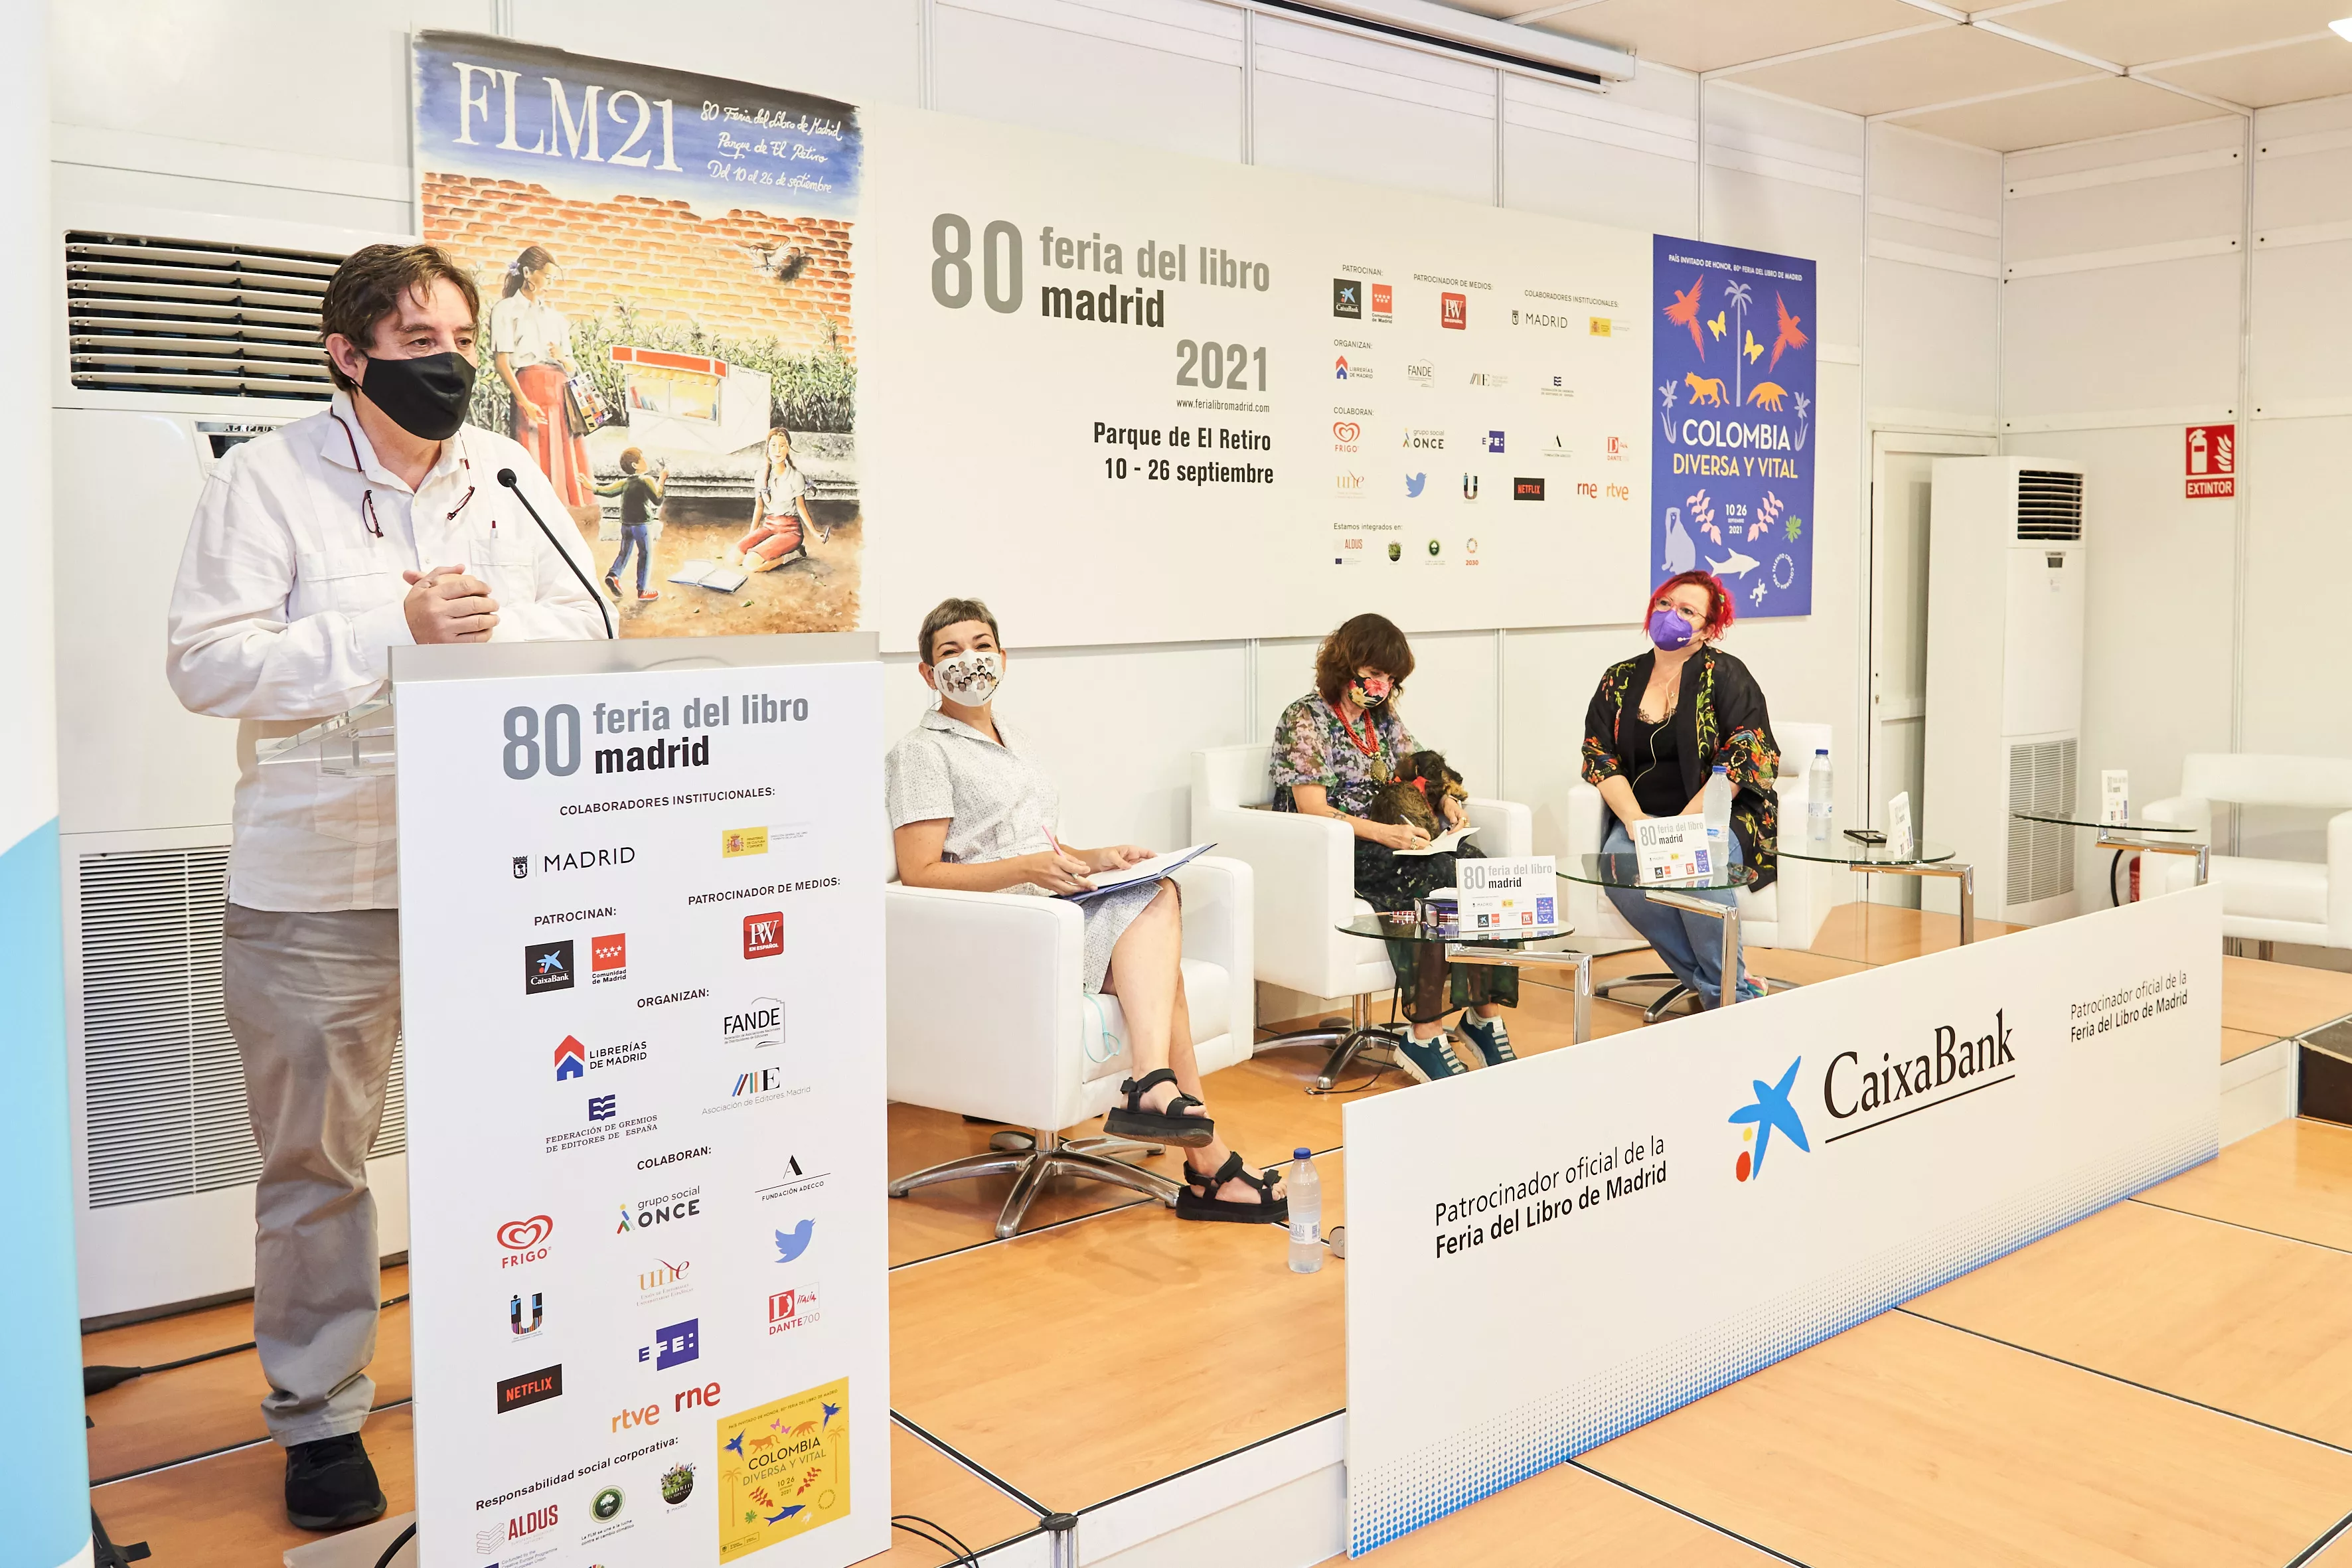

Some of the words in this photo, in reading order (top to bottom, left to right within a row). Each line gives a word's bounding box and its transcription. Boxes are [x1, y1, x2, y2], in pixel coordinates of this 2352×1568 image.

[452, 62, 683, 172] FLM21
[700, 100, 719, 121] 80
[724, 107, 752, 124] Feria
[753, 109, 769, 128] del
[769, 111, 795, 129] Libro
[797, 115, 808, 133] de
[807, 118, 842, 141] Madrid
[718, 131, 751, 159] Parque
[754, 139, 767, 154] de
[769, 141, 786, 158] El
[791, 143, 828, 163] Retiro
[708, 160, 731, 181] Del
[733, 167, 746, 181] 10
[747, 170, 758, 184] al
[759, 171, 773, 185] 26
[775, 172, 786, 187] de
[787, 173, 832, 195] septiembre
[931, 213, 1023, 314] 80
[1040, 226, 1123, 275] feria
[1137, 239, 1186, 282] del
[1200, 246, 1270, 292] libro
[1342, 264, 1383, 276] PATROCINAN:
[1669, 254, 1680, 263] PAÍS
[1680, 256, 1704, 266] INVITADO
[1413, 274, 1458, 286] PATROCINADOR
[1469, 281, 1493, 290] MEDIOS:
[1042, 284, 1164, 328] madrid
[1525, 289, 1571, 302] COLABORADORES
[1573, 296, 1618, 307] INSTITUCIONALES:
[1526, 313, 1568, 329] MADRID
[1334, 339, 1373, 349] ORGANIZAN:
[1176, 339, 1267, 392] 2021
[1408, 365, 1432, 377] FANDE
[1176, 398, 1270, 413] www.ferialibromadrid.com
[1334, 407, 1374, 416] COLABORAN:
[1094, 422, 1161, 450] Parque
[1168, 426, 1190, 448] de
[1198, 428, 1212, 449] El
[1219, 428, 1271, 451] Retiro
[1413, 438, 1445, 449] ONCE
[1682, 419, 1790, 451] COLOMBIA
[1335, 444, 1358, 453] FRIGO
[1105, 457, 1127, 479] 10
[1148, 459, 1170, 481] 26
[1176, 461, 1275, 487] septiembre
[1674, 453, 1739, 476] DIVERSA
[1743, 457, 1755, 477] Y
[1758, 457, 1798, 479] VITAL
[1518, 484, 1540, 494] NETFLIX
[1577, 483, 1597, 499] rne
[1607, 483, 1628, 501] rtve
[2187, 481, 2232, 496] EXTINTOR
[1726, 505, 1735, 516] 10
[1737, 505, 1747, 516] 26
[1345, 538, 1363, 549] ALDUS
[593, 700, 670, 734] feria
[683, 695, 730, 729] del
[742, 693, 809, 725] libro
[503, 704, 581, 780] 80
[595, 735, 710, 775] madrid
[560, 797, 669, 816] COLABORADORES
[672, 787, 776, 805] INSTITUCIONALES:
[1640, 826, 1657, 846] 80
[1658, 824, 1674, 833] feria
[1676, 822, 1686, 832] del
[1687, 821, 1703, 830] libro
[1659, 834, 1683, 844] madrid
[544, 846, 635, 873] MADRID
[1464, 866, 1485, 890] 80
[1488, 865, 1510, 876] feria
[1514, 864, 1528, 875] del
[1531, 864, 1552, 874] libro
[1488, 877, 1522, 889] madrid
[688, 886, 775, 905] PATROCINADOR
[778, 884, 792, 893] DE
[795, 877, 840, 891] MEDIOS:
[534, 907, 616, 925] PATROCINAN:
[749, 919, 779, 945] PW
[530, 973, 569, 985] CaixaBank
[592, 969, 626, 979] Comunidad
[637, 988, 710, 1008] ORGANIZAN:
[2071, 988, 2132, 1020] Patrocinador
[2136, 976, 2163, 999] oficial
[2165, 973, 2177, 990] de
[2179, 970, 2187, 985] la
[724, 1008, 780, 1035] FANDE
[2071, 1021, 2094, 1042] Feria
[2098, 1013, 2112, 1033] del
[2116, 1009, 2139, 1028] Libro
[2142, 1002, 2153, 1018] de
[2157, 988, 2187, 1014] Madrid
[589, 1041, 647, 1059] LIBRERÍAS
[590, 1060, 603, 1069] DE
[606, 1052, 647, 1066] MADRID
[1824, 1007, 2015, 1119] CaixaBank
[546, 1126, 601, 1144] FEDERACIÓN
[619, 1115, 657, 1128] GREMIOS
[561, 1135, 605, 1150] EDITORES
[625, 1124, 657, 1137] ESPAÑA
[637, 1145, 712, 1170] COLABORAN:
[762, 1188, 798, 1202] FUNDACIÓN
[799, 1181, 824, 1192] ADECCO
[1436, 1170, 1559, 1226] Patrocinador
[1565, 1146, 1617, 1183] oficial
[1624, 1141, 1644, 1164] de
[1651, 1135, 1664, 1156] la
[637, 1195, 668, 1212] grupo
[670, 1186, 700, 1202] social
[1437, 1225, 1483, 1259] Feria
[1490, 1209, 1519, 1239] del
[1527, 1200, 1572, 1228] Libro
[1579, 1186, 1600, 1210] de
[1607, 1160, 1666, 1200] Madrid
[637, 1199, 700, 1228] ONCE
[637, 1258, 690, 1290] une
[769, 1312, 821, 1335] DANTE700
[506, 1376, 552, 1402] NETFLIX
[611, 1403, 660, 1433] rtve
[674, 1381, 721, 1413] rne
[748, 1437, 821, 1470] COLOMBIA
[476, 1470, 575, 1511] Responsabilidad
[578, 1457, 611, 1478] social
[613, 1437, 678, 1464] corporativa:
[743, 1464, 786, 1486] DIVERSA
[789, 1458, 796, 1468] Y
[799, 1449, 826, 1464] VITAL
[509, 1504, 558, 1540] ALDUS
